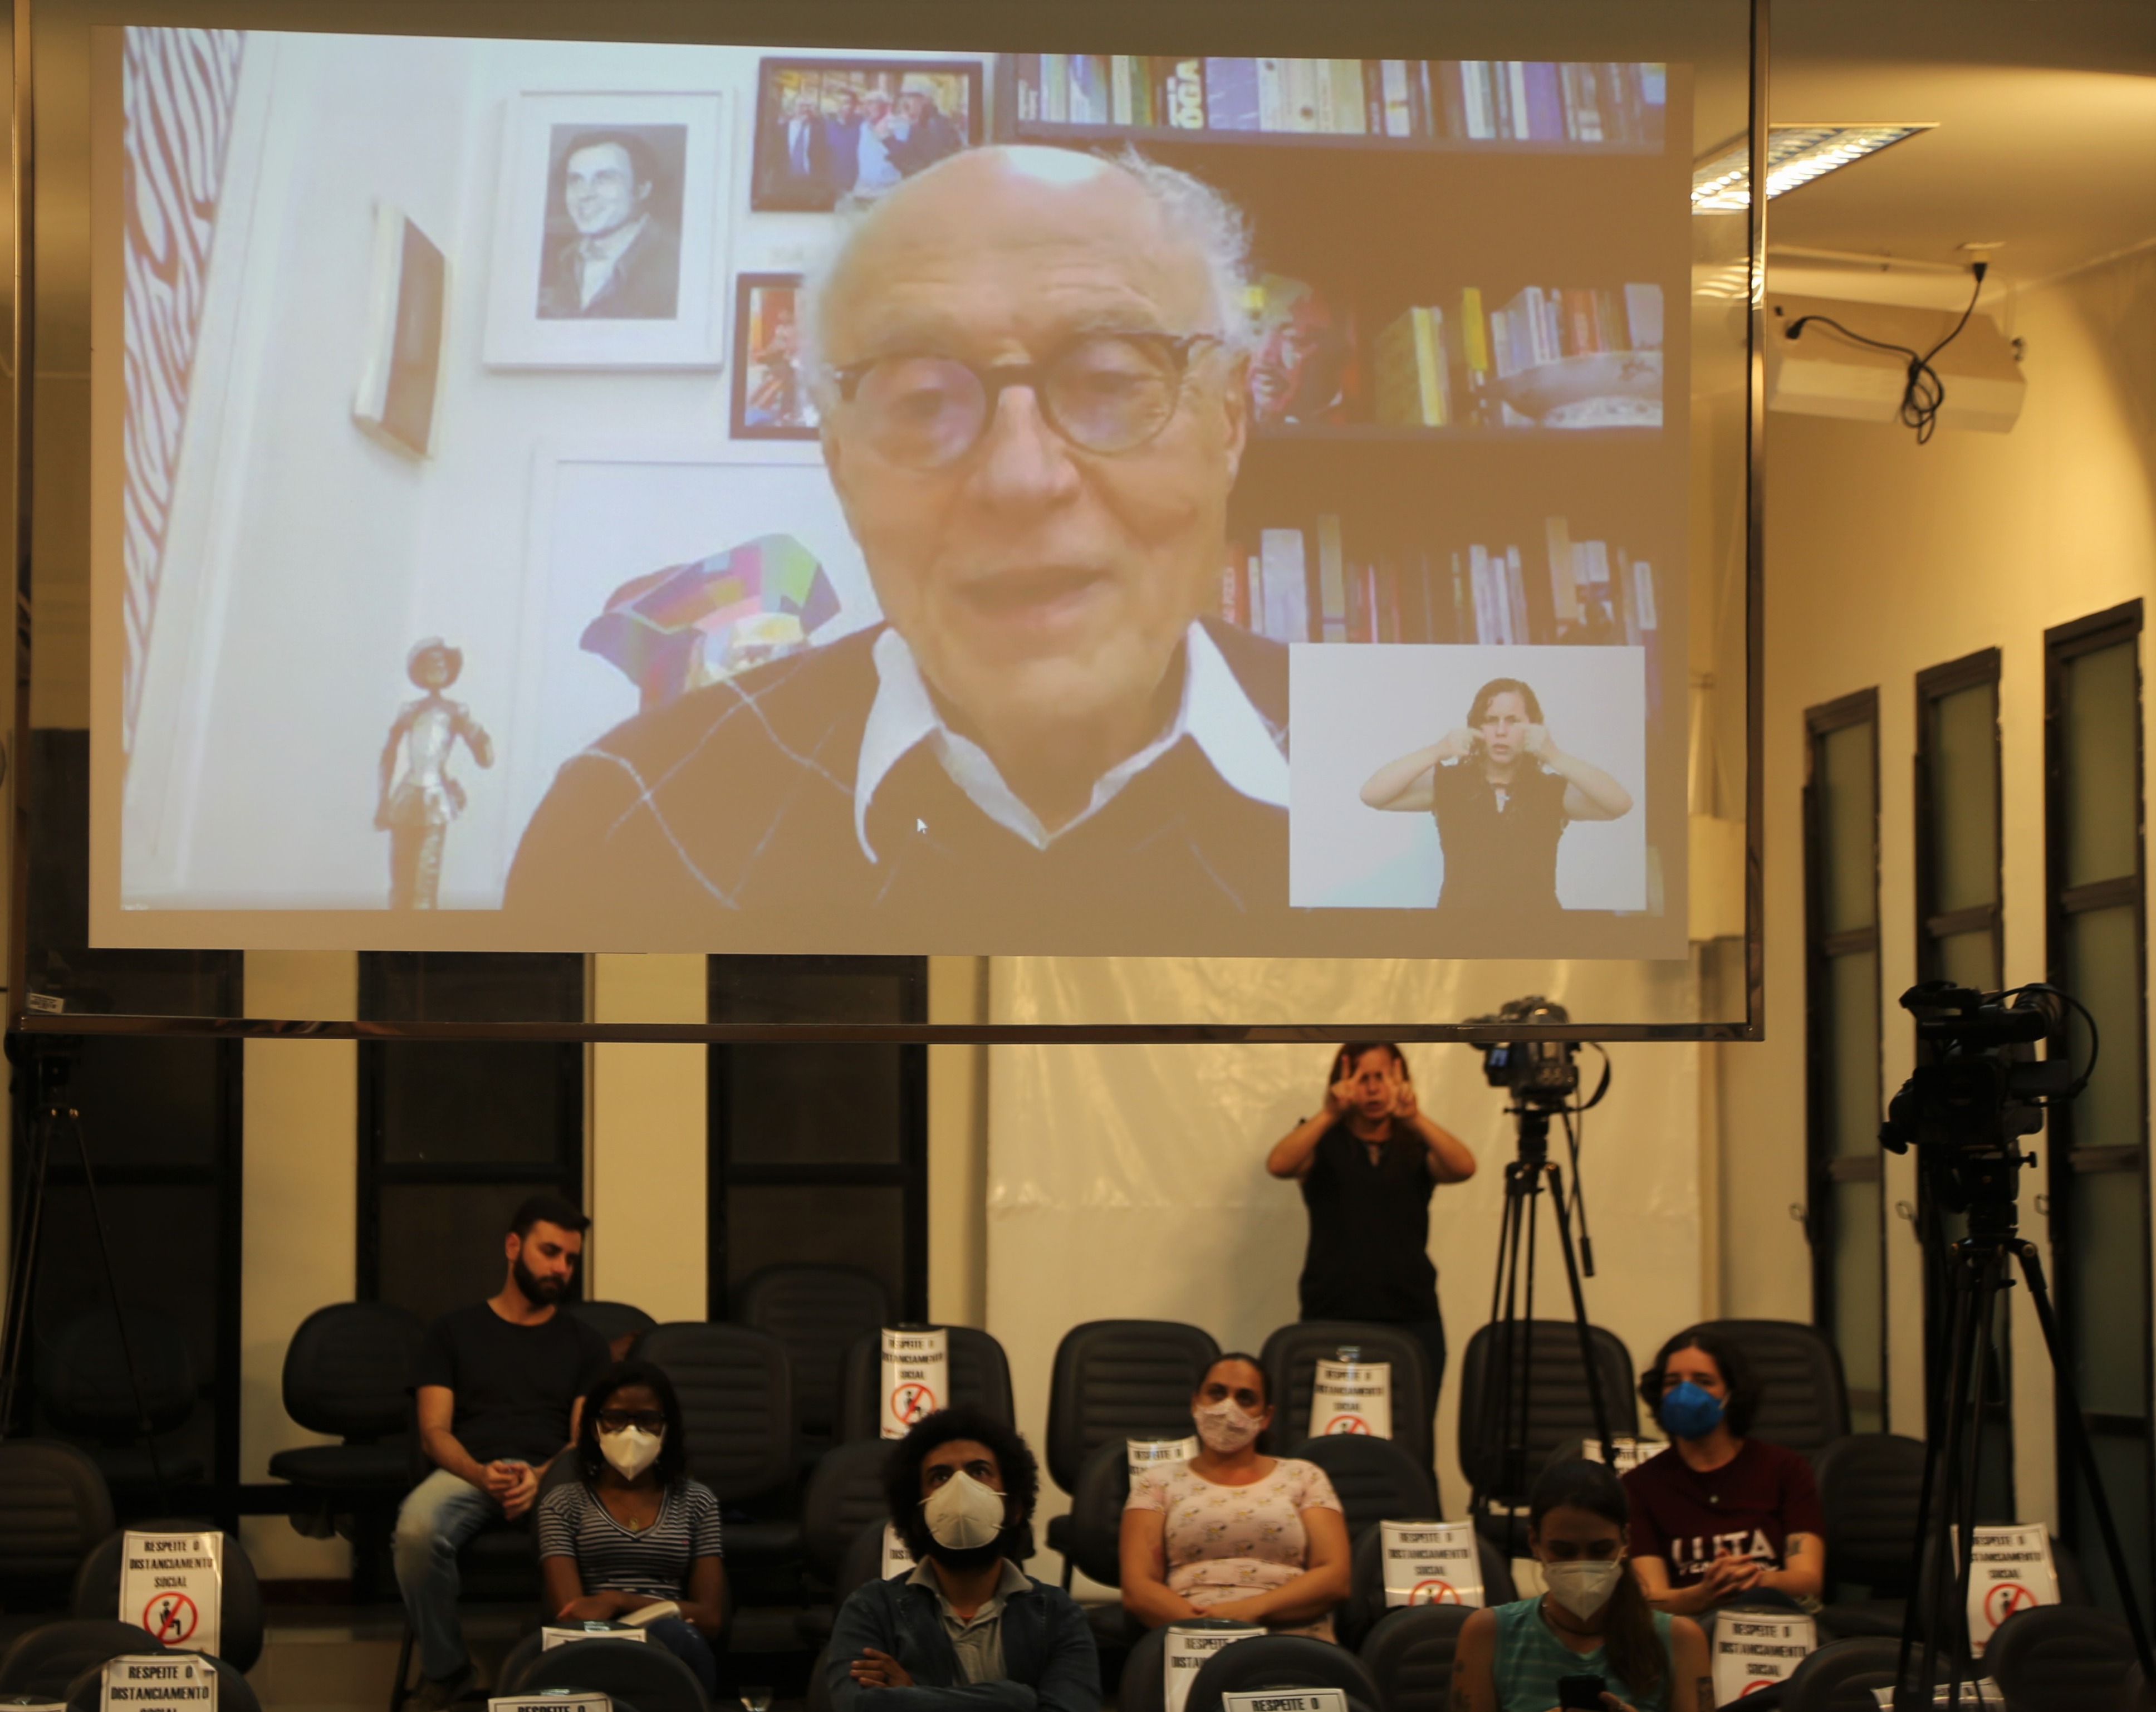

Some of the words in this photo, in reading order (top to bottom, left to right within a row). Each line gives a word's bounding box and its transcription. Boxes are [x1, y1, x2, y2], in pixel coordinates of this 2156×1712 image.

[889, 1339, 923, 1349] RSPEITE
[881, 1351, 943, 1363] DISTNCIAMENTO
[144, 1540, 187, 1552] RESPEITE
[193, 1540, 199, 1551] O
[1972, 1552, 2041, 1562] STANCIAMENTO
[129, 1558, 214, 1570] DISTANCIAMENTO
[154, 1576, 187, 1588] SOCIAL
[129, 1665, 179, 1679] RESPEITE
[185, 1665, 193, 1678] O
[111, 1686, 209, 1700] DISTANCIAMENTO
[1252, 1699, 1305, 1712] RESPEITE
[1311, 1698, 1320, 1710] O
